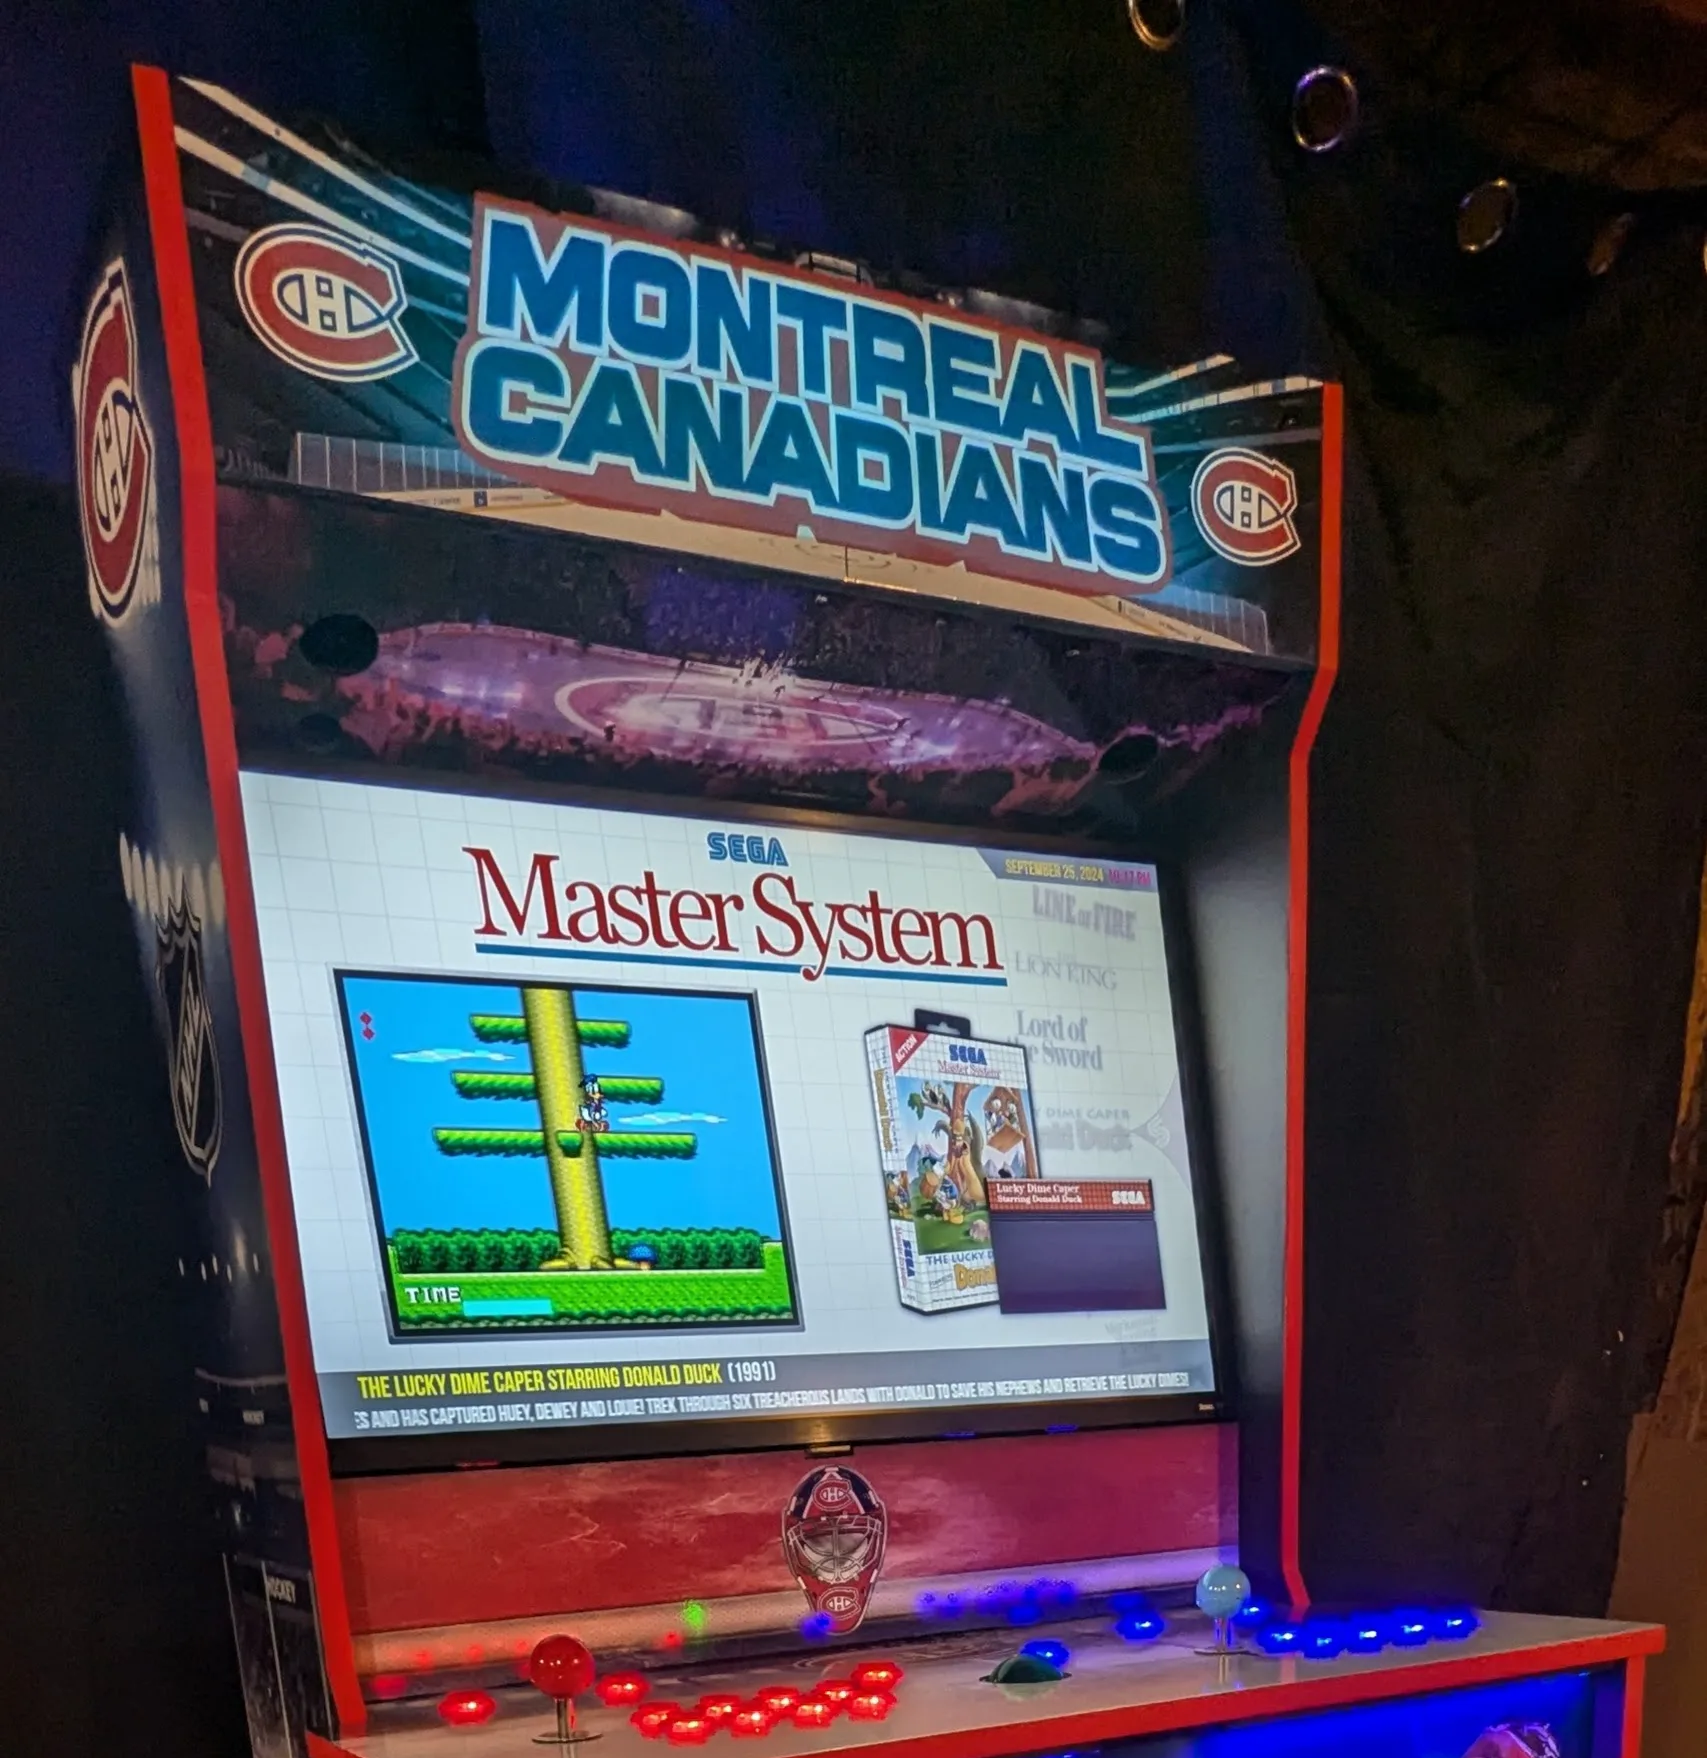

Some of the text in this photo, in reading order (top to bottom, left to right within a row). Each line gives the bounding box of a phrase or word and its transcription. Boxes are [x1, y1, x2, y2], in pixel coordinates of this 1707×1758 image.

[476, 210, 1149, 480] MONTREAL
[462, 337, 1167, 585] CANADIANS
[707, 832, 789, 867] SEGA
[1005, 858, 1062, 879] SEPTEMBER
[1080, 866, 1104, 882] 2024
[462, 846, 1004, 981] Master System
[1032, 884, 1077, 926] LINE
[1093, 901, 1137, 942] FIRE
[1015, 951, 1061, 981] LION
[1016, 1009, 1089, 1044] Lord of
[894, 1034, 919, 1064] ACTION
[948, 1044, 988, 1066] SEGA
[1042, 1039, 1104, 1071] Sword
[1046, 1107, 1081, 1120] DIME
[996, 1183, 1081, 1196] Lucky Dime Caper
[997, 1194, 1083, 1206] Starring Donald Duck
[1111, 1190, 1146, 1206] SEGA
[926, 1254, 949, 1266] THE
[951, 1250, 985, 1264] LUCKY
[405, 1286, 461, 1304] TIME
[357, 1360, 776, 1399] THE LUCKY DIME CAPER STARRING DONALD DUCK (1991)
[371, 1409, 400, 1429] AND
[400, 1408, 429, 1427] HAS
[429, 1405, 497, 1426] CAPTURED
[497, 1403, 534, 1423] HUEY,
[535, 1401, 577, 1421] DEWEY
[581, 1400, 606, 1418] AND
[607, 1398, 645, 1417] LOUIE!
[646, 1397, 678, 1415] TREK
[678, 1394, 732, 1413] THROUGH
[732, 1392, 753, 1410] SIX
[752, 1389, 830, 1409] TREACHEROUS
[830, 1387, 866, 1405] LANDS
[866, 1386, 894, 1403] WITH
[894, 1384, 936, 1402] DONALD
[936, 1383, 950, 1400] TO
[951, 1382, 977, 1399] SAVE
[977, 1381, 995, 1397] HIS
[995, 1379, 1042, 1396] NEPHEWS
[1043, 1378, 1063, 1394] AND
[1063, 1375, 1108, 1392] RETRIEVE
[1108, 1374, 1127, 1391] THE
[1127, 1373, 1157, 1389] LUCKY
